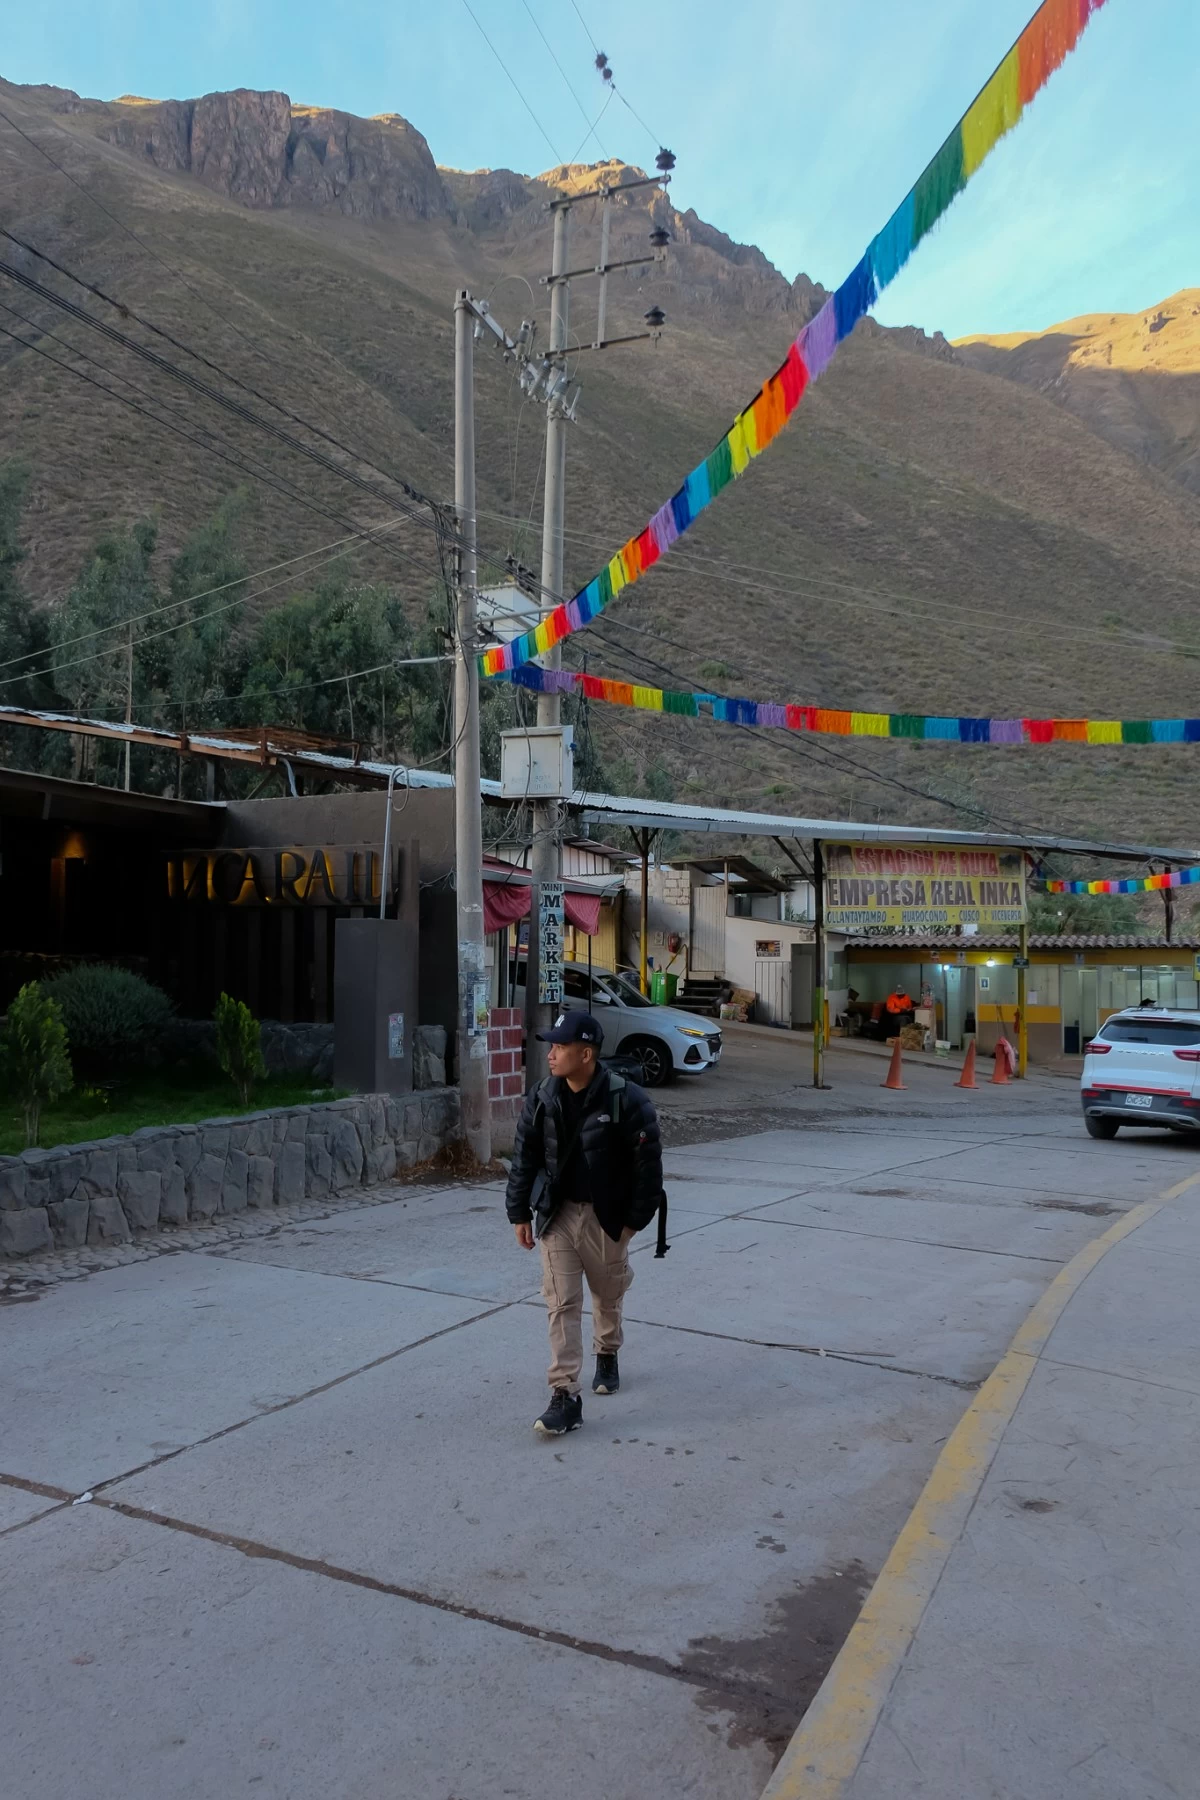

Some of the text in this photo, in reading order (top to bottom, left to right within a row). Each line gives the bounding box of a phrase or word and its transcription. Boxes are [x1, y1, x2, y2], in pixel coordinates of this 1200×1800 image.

[937, 850, 957, 877] DE
[959, 851, 998, 877] RUTA
[542, 883, 562, 892] MINI
[828, 879, 1022, 906] EMPRESA REAL INKA
[827, 910, 887, 924] OLLANTAYTAMBO
[902, 910, 947, 922] HUAROCONDO
[959, 910, 980, 922] CUSCO
[991, 909, 1022, 921] VICEVERSA
[543, 894, 561, 1002] MARKET
